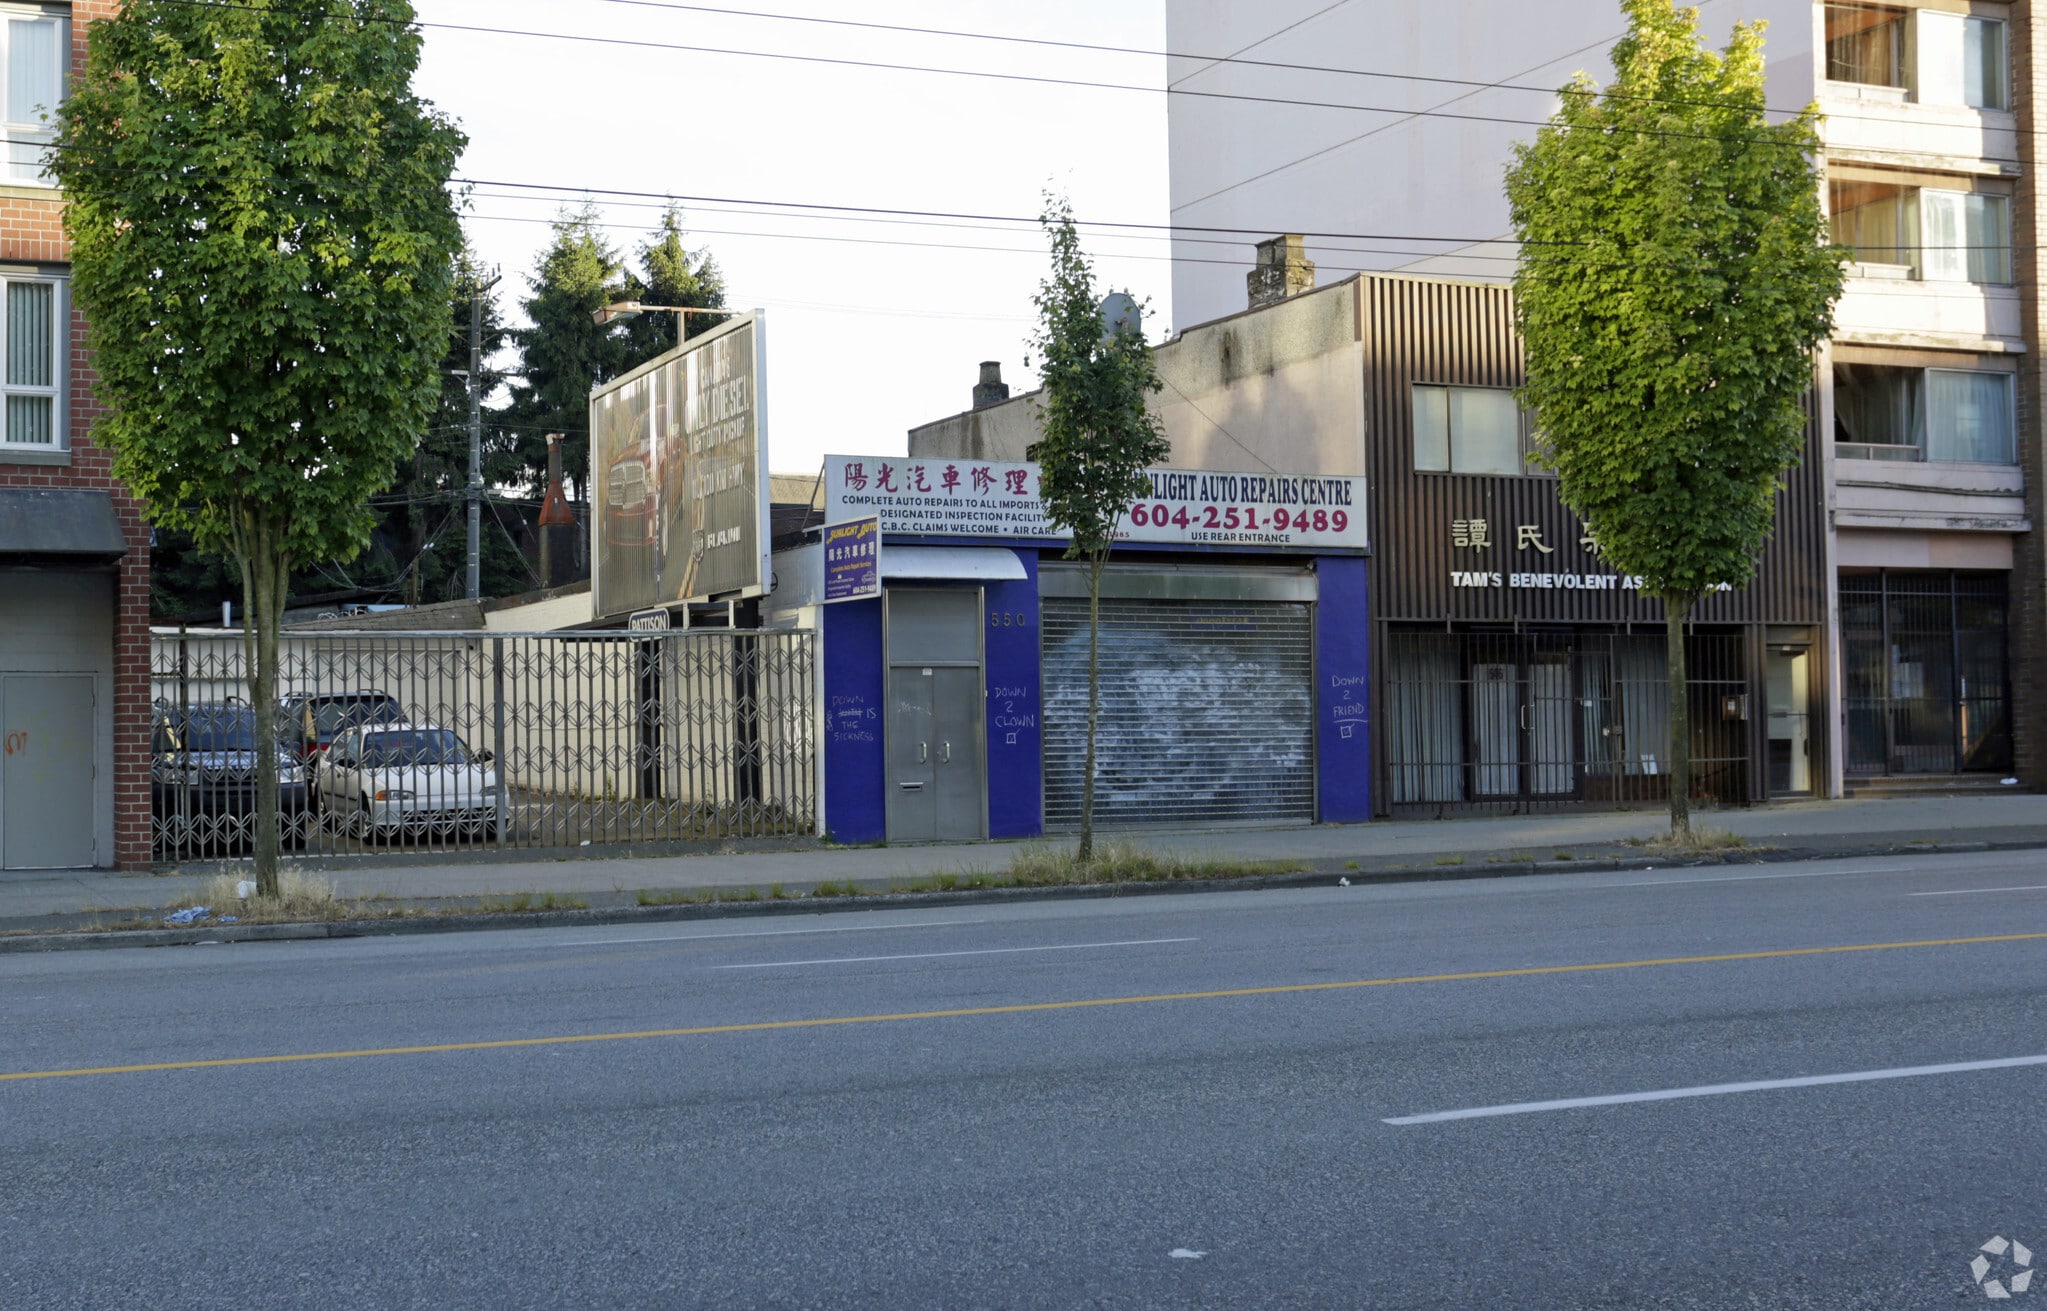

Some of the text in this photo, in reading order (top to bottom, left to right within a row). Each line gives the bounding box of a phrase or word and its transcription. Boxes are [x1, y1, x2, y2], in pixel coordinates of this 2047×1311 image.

[844, 463, 1044, 497] 陽光汽車修理
[1132, 472, 1352, 506] NLIGHT AUTO REPAIRS CENTRE
[842, 495, 894, 506] COMPLETE
[896, 497, 922, 506] AUTO
[924, 498, 963, 508] REPAIRS
[965, 499, 978, 508] TO
[980, 500, 997, 509] ALL
[999, 501, 1039, 510] IMPORTS
[881, 509, 1047, 522] DESIGNATED INSPECTION FACILITY
[1131, 503, 1348, 533] 604-251-9489
[912, 522, 948, 532] CLAIMS
[951, 524, 999, 534] WELCOME
[1013, 526, 1030, 535] AIR
[1191, 532, 1291, 543] USE REAR ENTRANCE
[1450, 571, 1502, 588] TAM'S
[1509, 573, 1617, 590] BENEVOLENT
[632, 615, 666, 631] PATTISON
[991, 612, 1026, 627] 550
[1331, 674, 1365, 687] DOWN
[995, 687, 1026, 698] DOWN
[1343, 690, 1352, 700] 2
[832, 695, 864, 706] DOWN
[1004, 700, 1014, 713] 2
[1333, 703, 1365, 718] FRIEND
[995, 714, 1034, 727] CLOWN
